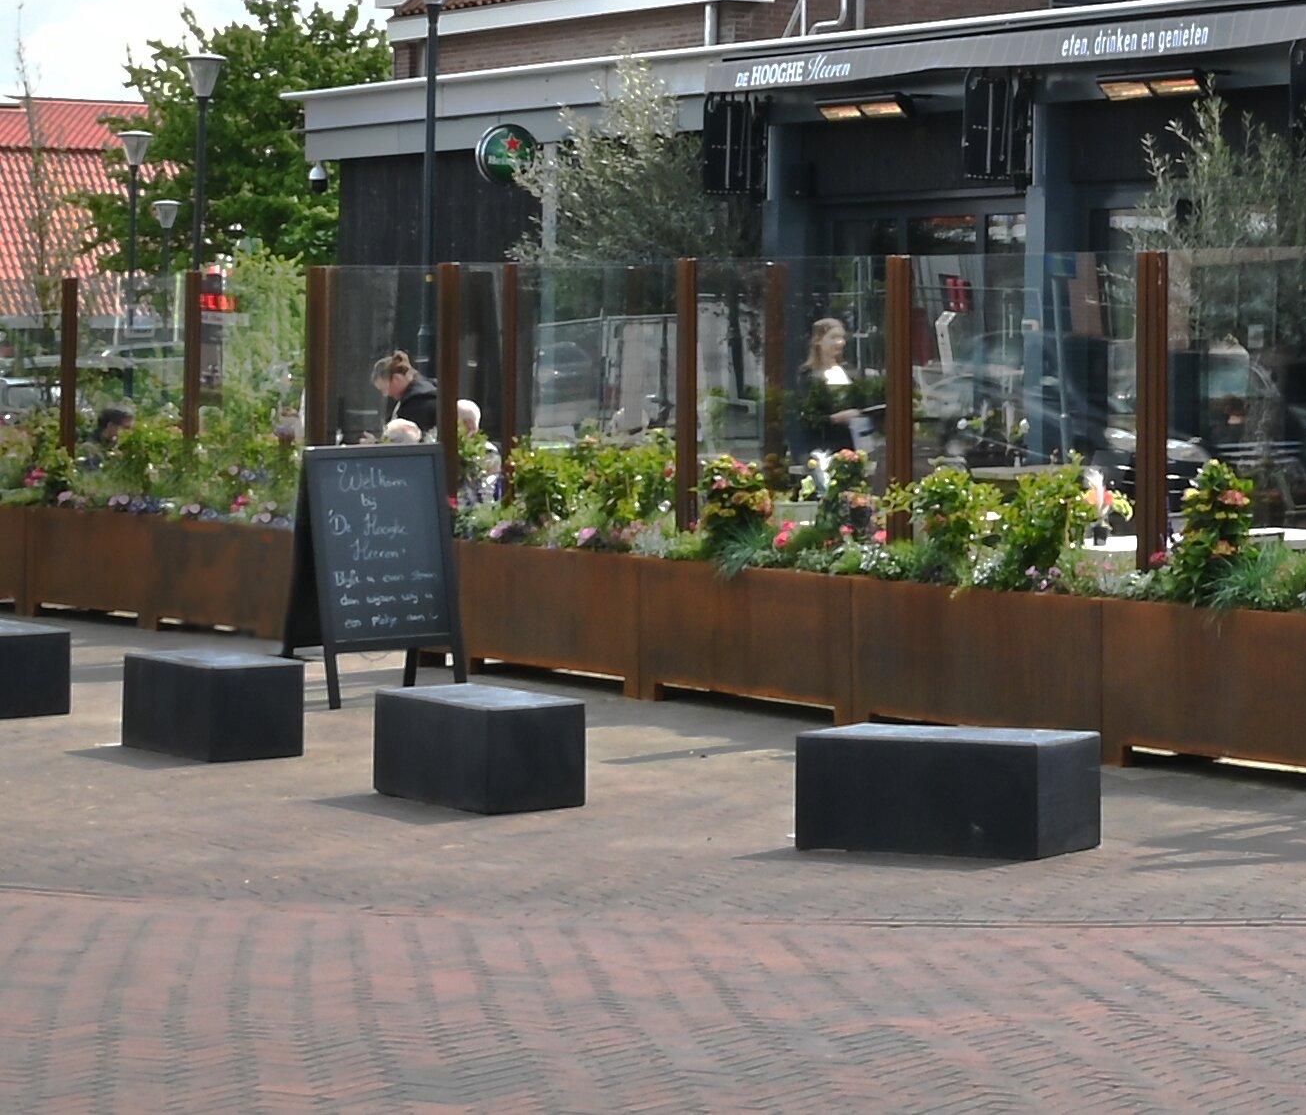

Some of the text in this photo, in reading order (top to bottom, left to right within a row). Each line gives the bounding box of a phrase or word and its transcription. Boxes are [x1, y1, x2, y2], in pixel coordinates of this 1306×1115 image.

[1094, 28, 1138, 55] drinken
[1141, 32, 1155, 50] en
[1158, 23, 1209, 53] genieten
[735, 72, 749, 87] DE
[750, 61, 805, 85] HOOGHE
[337, 462, 407, 492] Welkom
[363, 513, 408, 539] Hooghe
